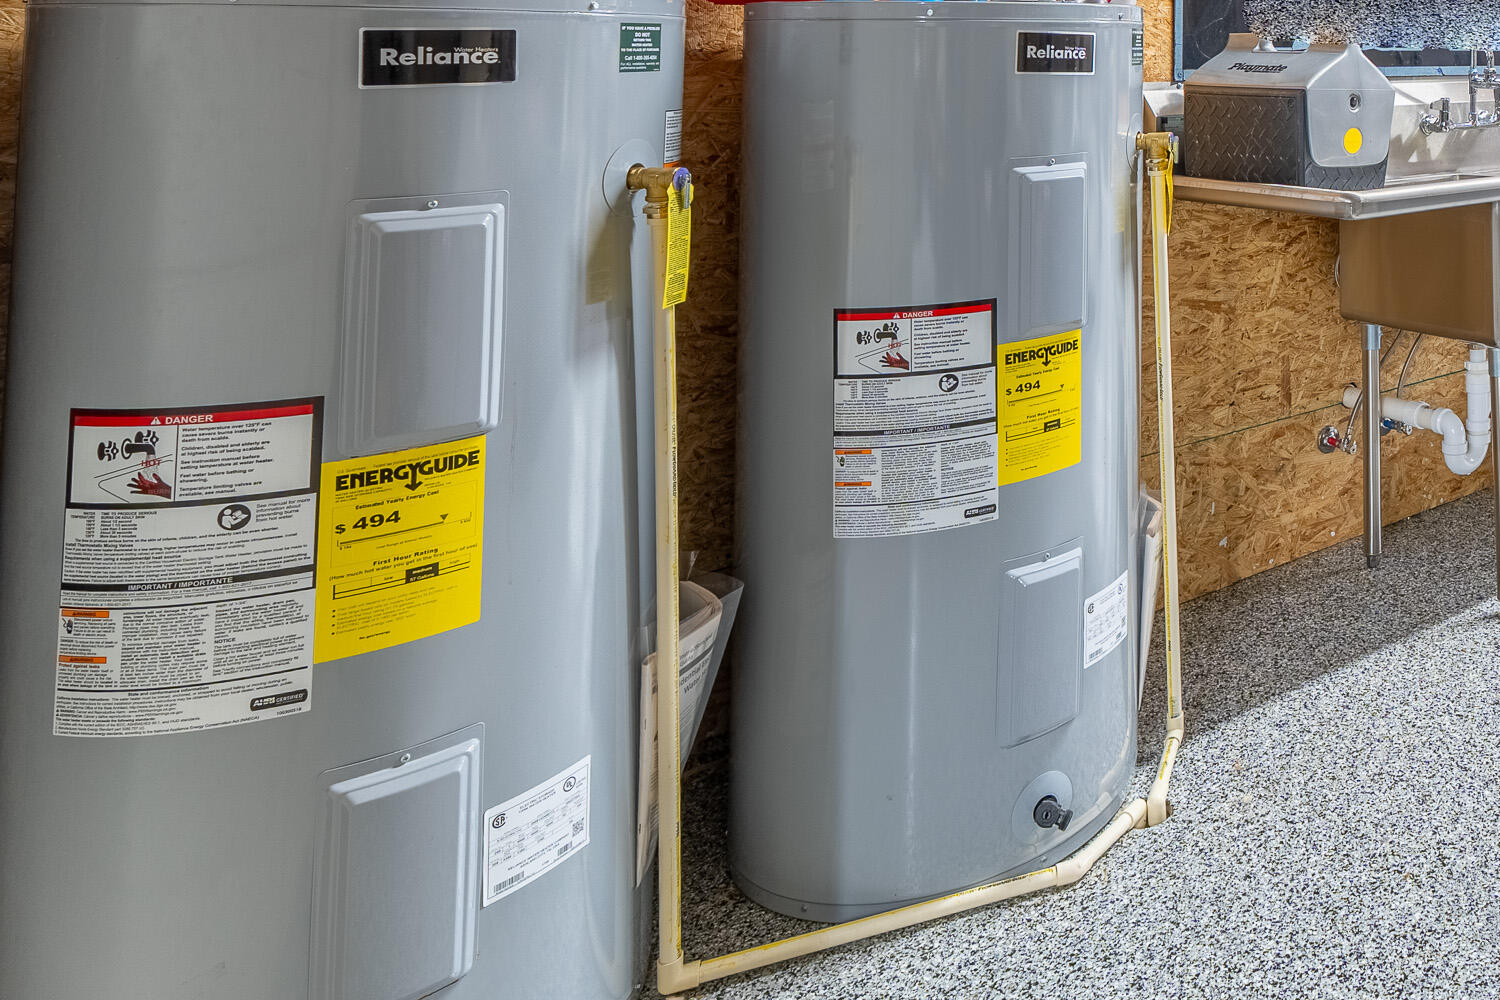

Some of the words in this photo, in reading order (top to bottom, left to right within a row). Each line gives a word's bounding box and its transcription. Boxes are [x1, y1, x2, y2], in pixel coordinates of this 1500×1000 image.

[380, 46, 499, 66] Reliance
[1027, 45, 1086, 59] Reliance
[1227, 61, 1288, 74] Playmate
[1005, 339, 1078, 367] ENERGYGUIDE
[1006, 388, 1012, 396] $
[1015, 380, 1040, 393] 494
[165, 414, 213, 425] DANGER
[335, 450, 480, 491] ENERGYGUIDE
[355, 500, 384, 510] Estimated
[386, 496, 404, 505] Yearly
[406, 492, 426, 501] Energy
[335, 524, 346, 535] $
[352, 510, 400, 529] 494
[373, 558, 391, 566] First
[393, 554, 412, 562] Hour
[414, 548, 439, 557] Rating
[128, 582, 172, 591] IMPORTANT
[178, 576, 233, 588] IMPORTANTE
